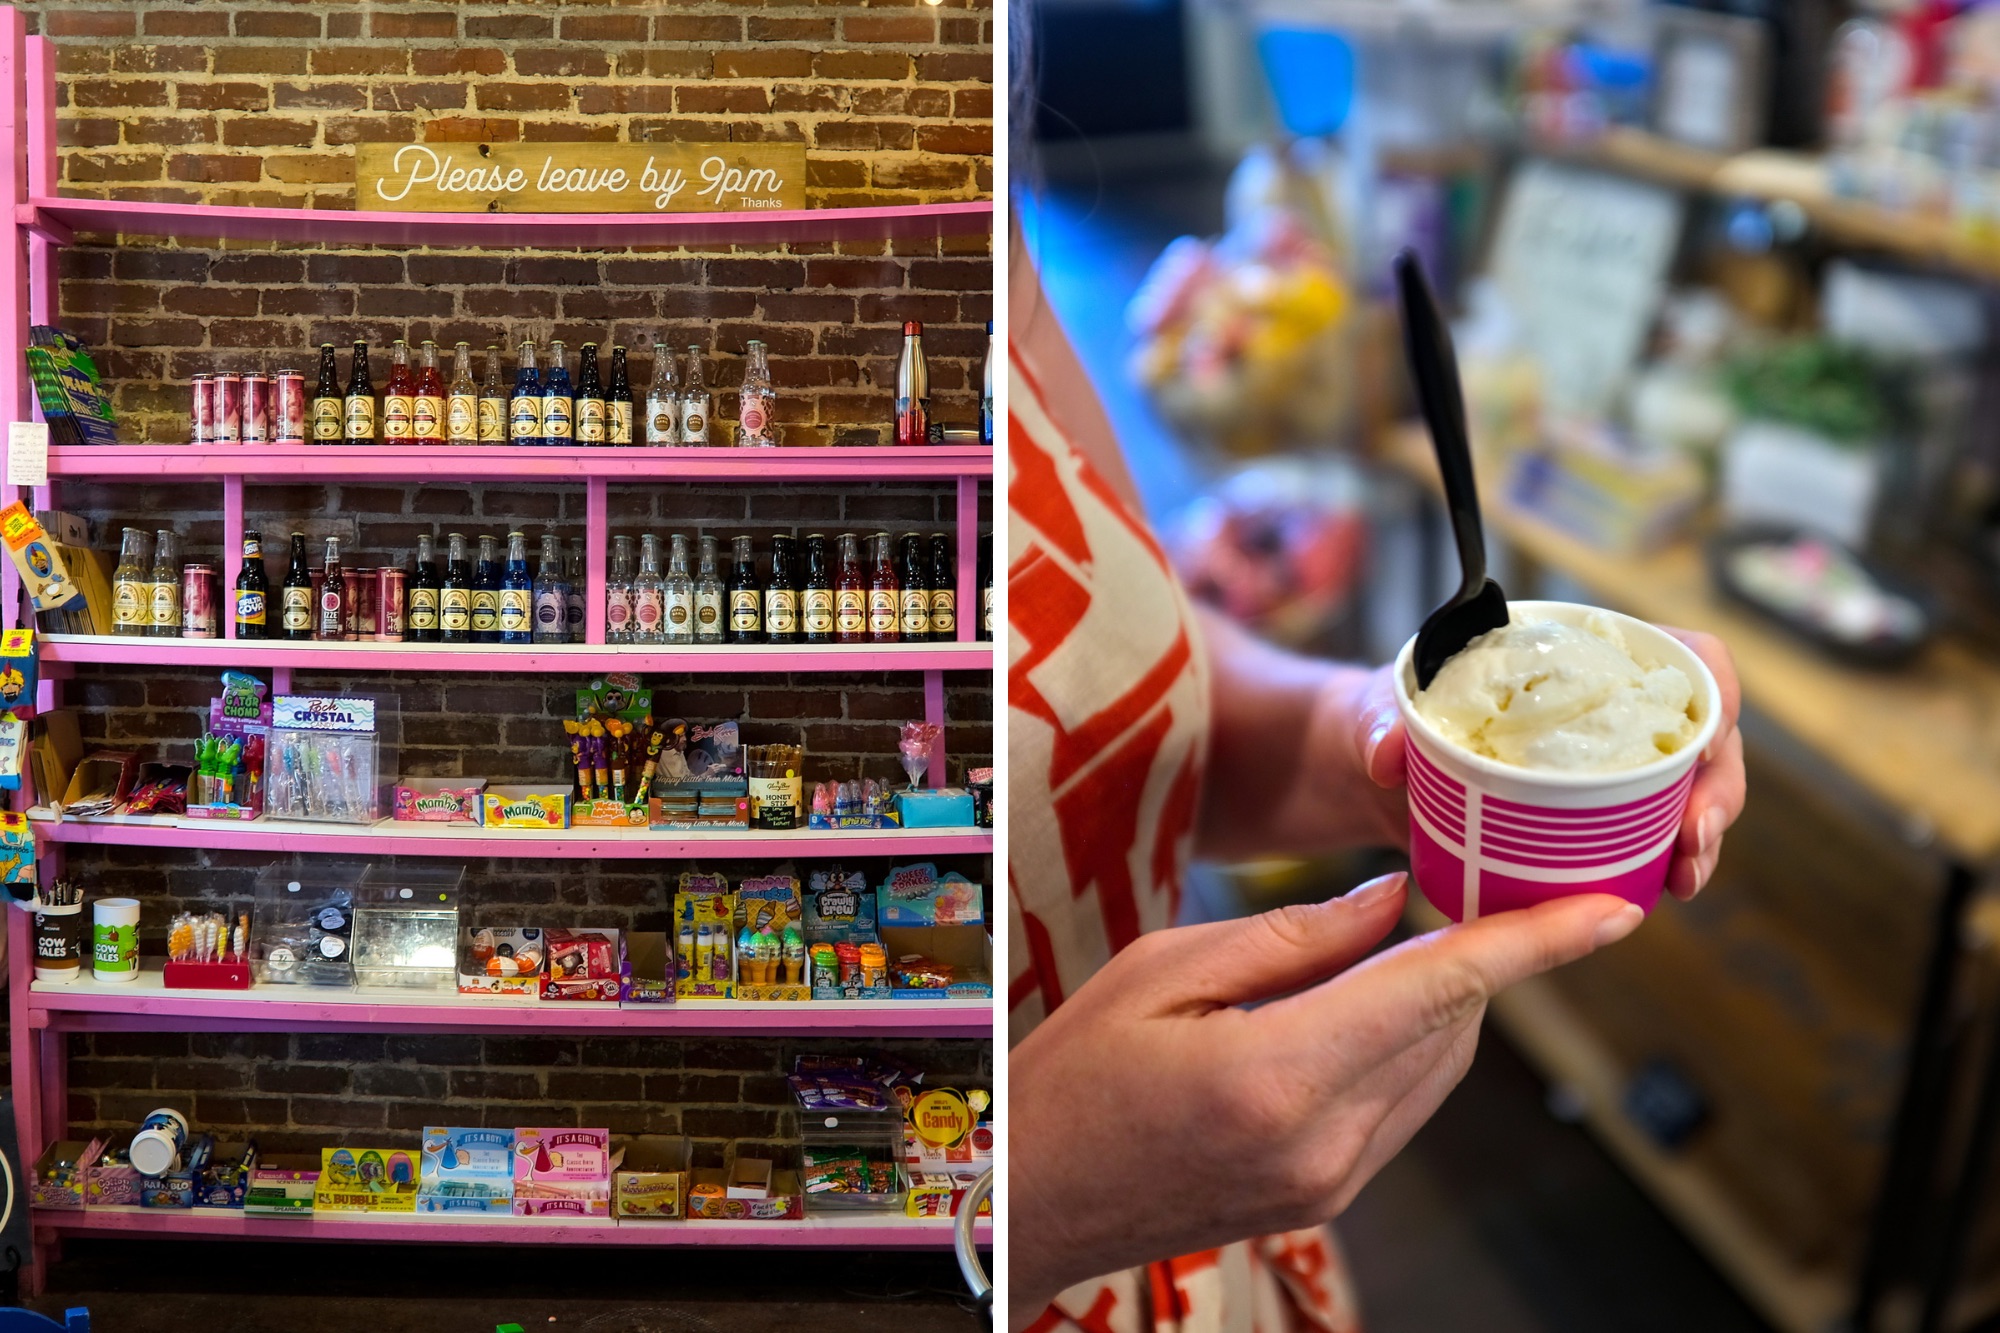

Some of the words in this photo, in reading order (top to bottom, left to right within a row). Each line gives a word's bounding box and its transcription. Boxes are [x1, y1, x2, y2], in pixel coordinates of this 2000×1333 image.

[376, 145, 528, 201] Please
[536, 156, 630, 193] leave
[640, 156, 686, 210] by
[695, 156, 783, 204] 9pm
[740, 196, 783, 208] Thanks
[239, 596, 262, 607] MALTA
[238, 602, 264, 614] GOYA
[226, 695, 260, 708] GATOR
[308, 699, 339, 715] Rock
[224, 706, 260, 718] CHOMP
[294, 710, 355, 723] CRYSTAL
[656, 776, 682, 785] Happy
[682, 775, 702, 783] Little
[722, 774, 744, 783] Mints
[416, 797, 458, 812] Mamba
[504, 803, 546, 819] Mamba
[670, 820, 692, 830] Happy
[895, 868, 926, 880] SWEET
[742, 876, 791, 891] SUNDAE
[740, 888, 793, 901] SQUEEZE
[821, 896, 854, 906] Crawly
[38, 937, 66, 948] COW
[38, 946, 67, 957] TALES
[96, 944, 118, 954] COW
[96, 952, 119, 962] TALES
[922, 1112, 963, 1132] Candy
[464, 1134, 478, 1142] IT'S
[486, 1134, 502, 1144] BOY!
[556, 1134, 570, 1144] IT'S
[572, 1134, 577, 1142] A
[578, 1134, 596, 1144] GIRL!
[98, 1178, 130, 1188] Cotton
[102, 1185, 132, 1196] Candy
[334, 1194, 379, 1205] BUBBLE
[466, 1200, 480, 1208] BOY!
[546, 1202, 557, 1210] IT'S
[564, 1202, 580, 1210] GIRL!
